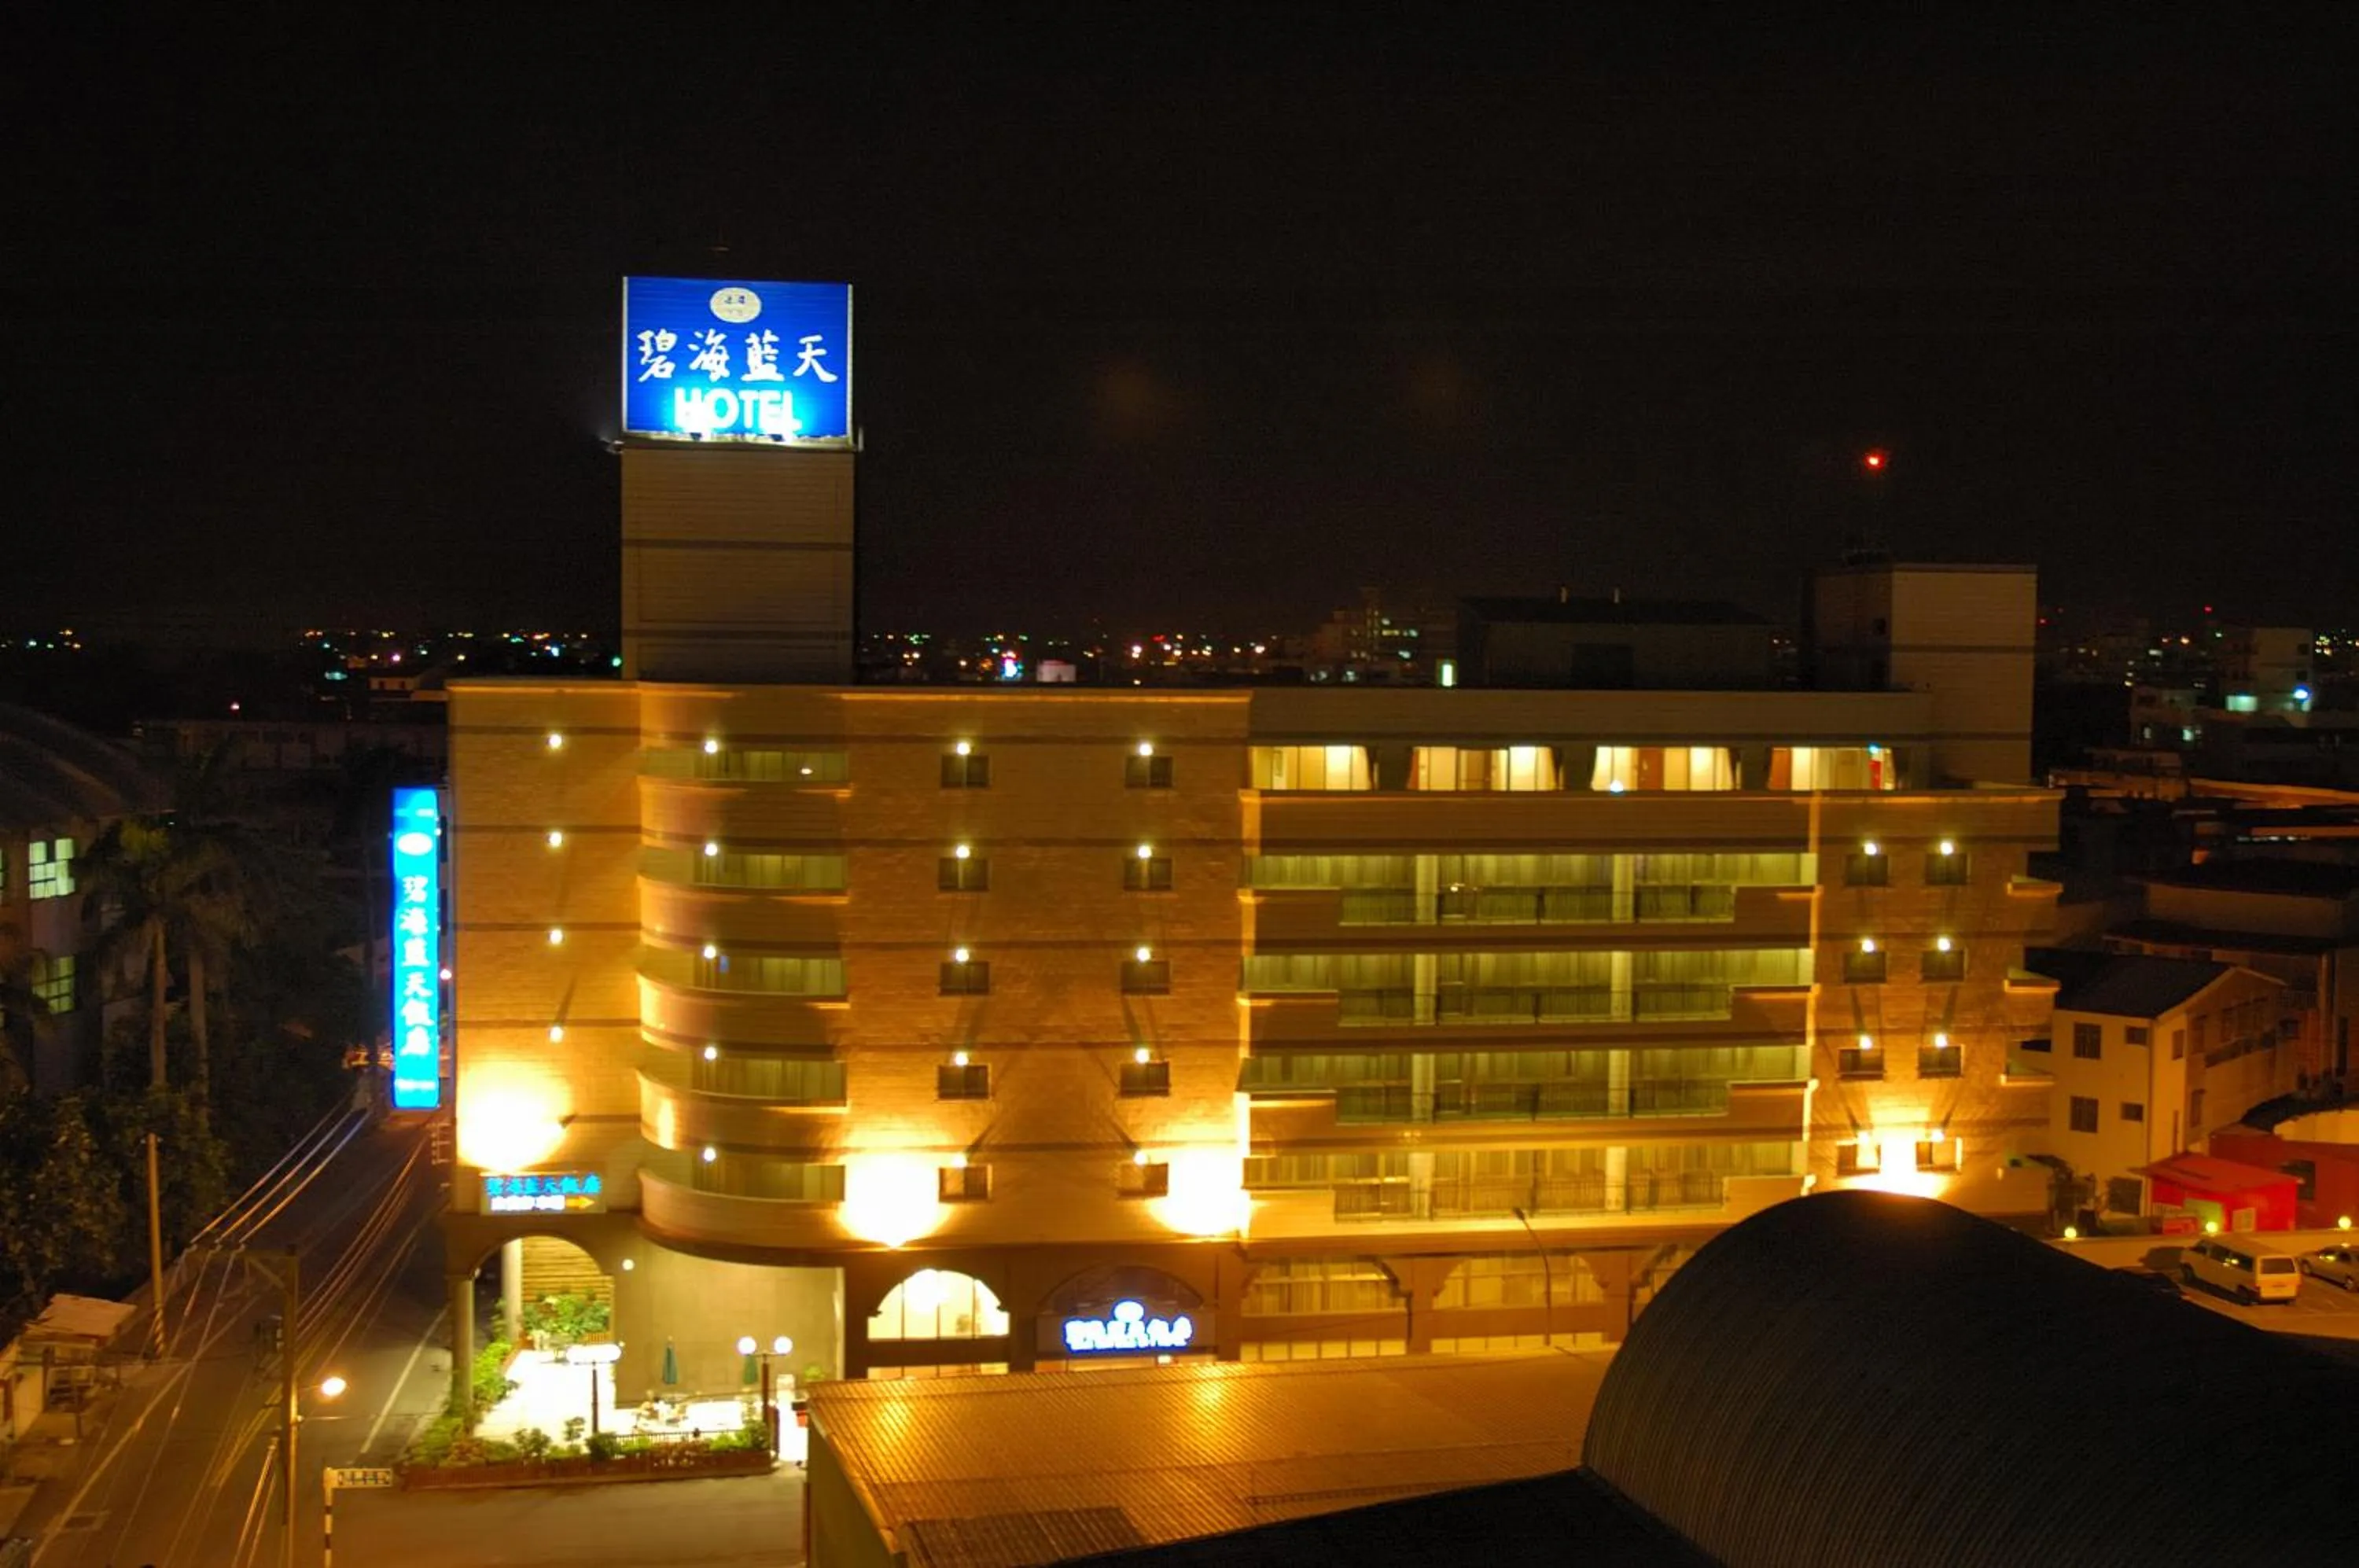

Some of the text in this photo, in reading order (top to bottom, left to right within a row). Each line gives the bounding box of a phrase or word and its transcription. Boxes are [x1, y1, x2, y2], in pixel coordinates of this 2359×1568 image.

[637, 328, 838, 383] 碧海藍天
[674, 388, 802, 433] HOTEL
